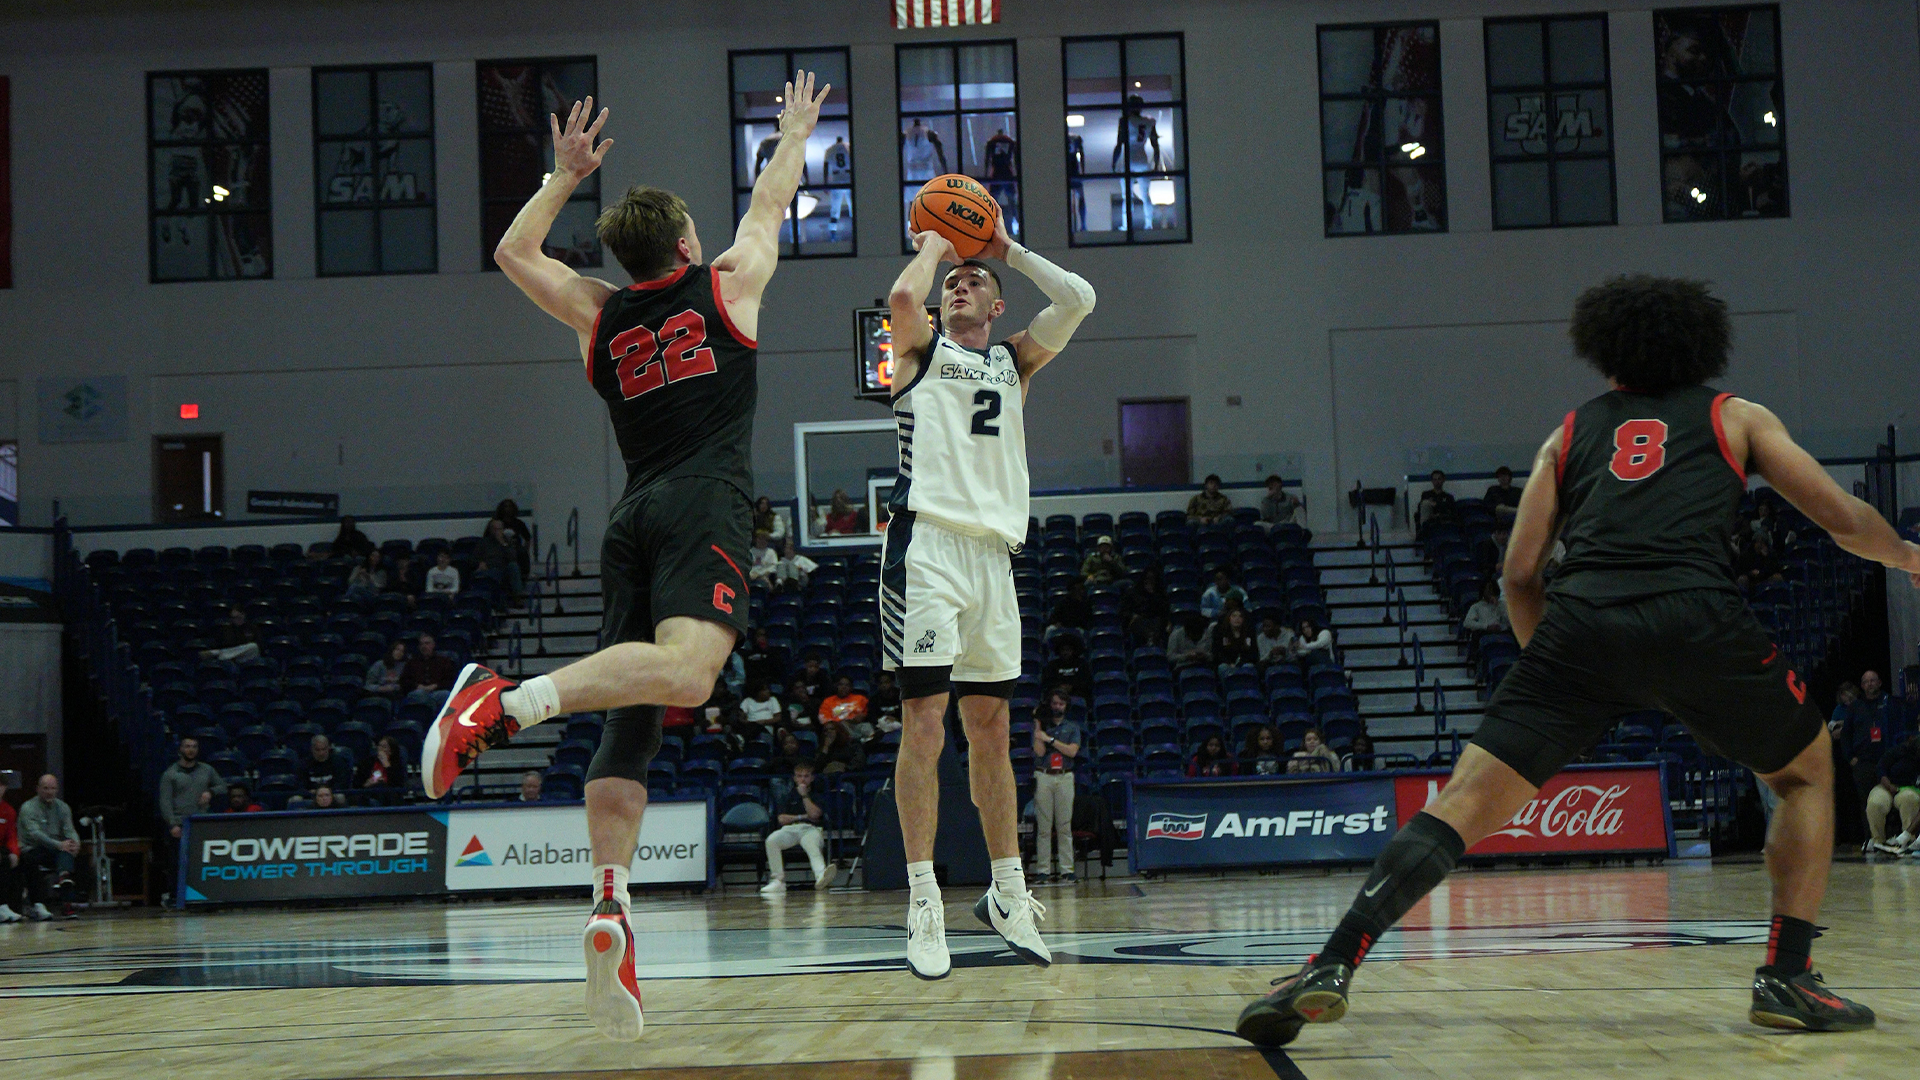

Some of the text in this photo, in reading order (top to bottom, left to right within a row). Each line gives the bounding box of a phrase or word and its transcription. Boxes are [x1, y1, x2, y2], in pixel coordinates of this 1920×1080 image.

[946, 201, 986, 229] NCAA
[608, 308, 718, 401] 22
[971, 389, 1002, 437] 2
[1608, 418, 1668, 481] 8
[712, 582, 736, 614] C
[1211, 805, 1388, 839] AmFirst
[202, 832, 430, 863] POWERADE
[501, 842, 699, 866] Alabam ower
[201, 858, 428, 881] POWER THROUGH
